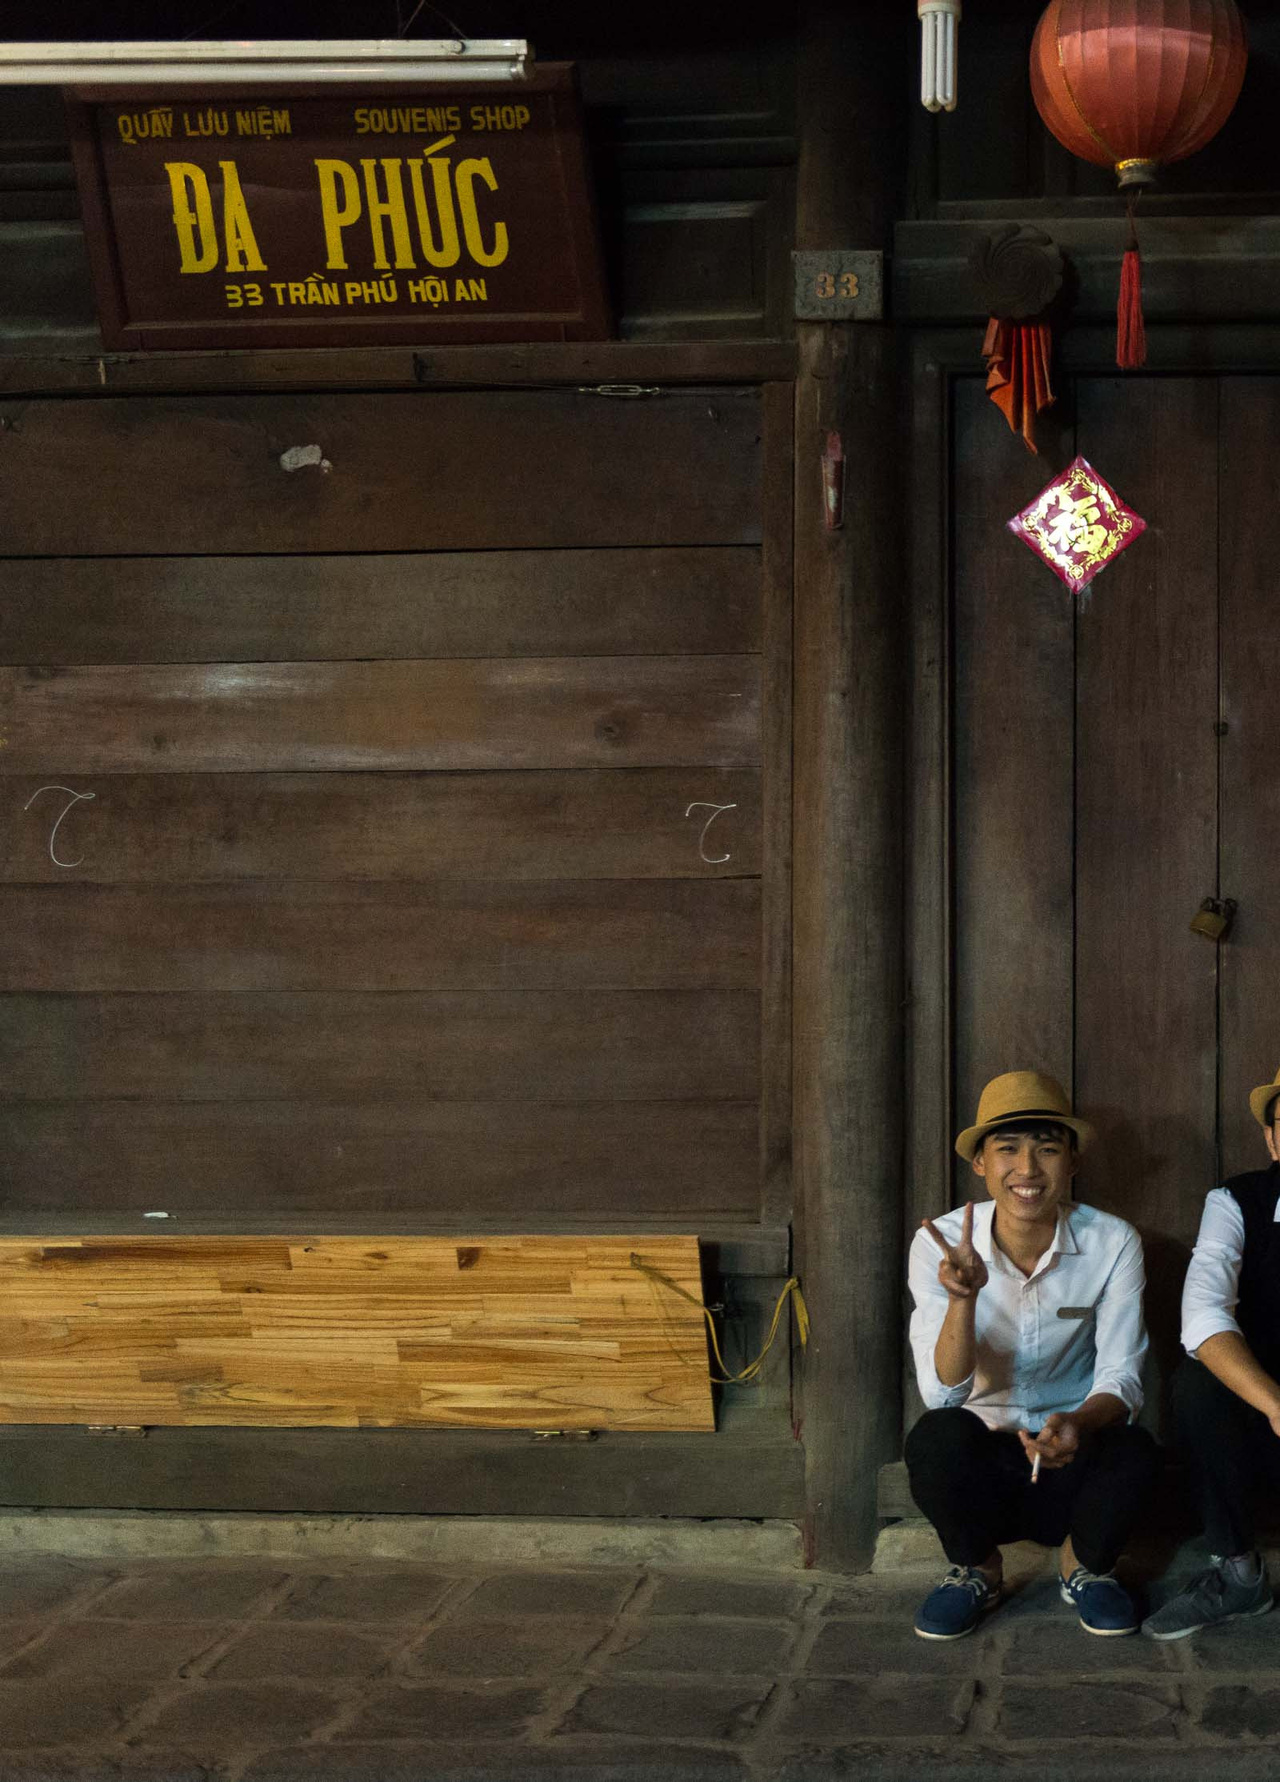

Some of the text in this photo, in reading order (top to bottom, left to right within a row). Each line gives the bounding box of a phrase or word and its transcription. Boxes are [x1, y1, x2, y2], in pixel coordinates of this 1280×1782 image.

[182, 107, 230, 137] LƯU
[235, 105, 293, 141] NIỆM
[354, 104, 531, 134] SOUVENIS SHOP
[164, 133, 510, 274] ĐA PHÚC
[225, 272, 488, 308] 33 TRẦN PHÚ HỘI AN
[815, 271, 859, 299] 33
